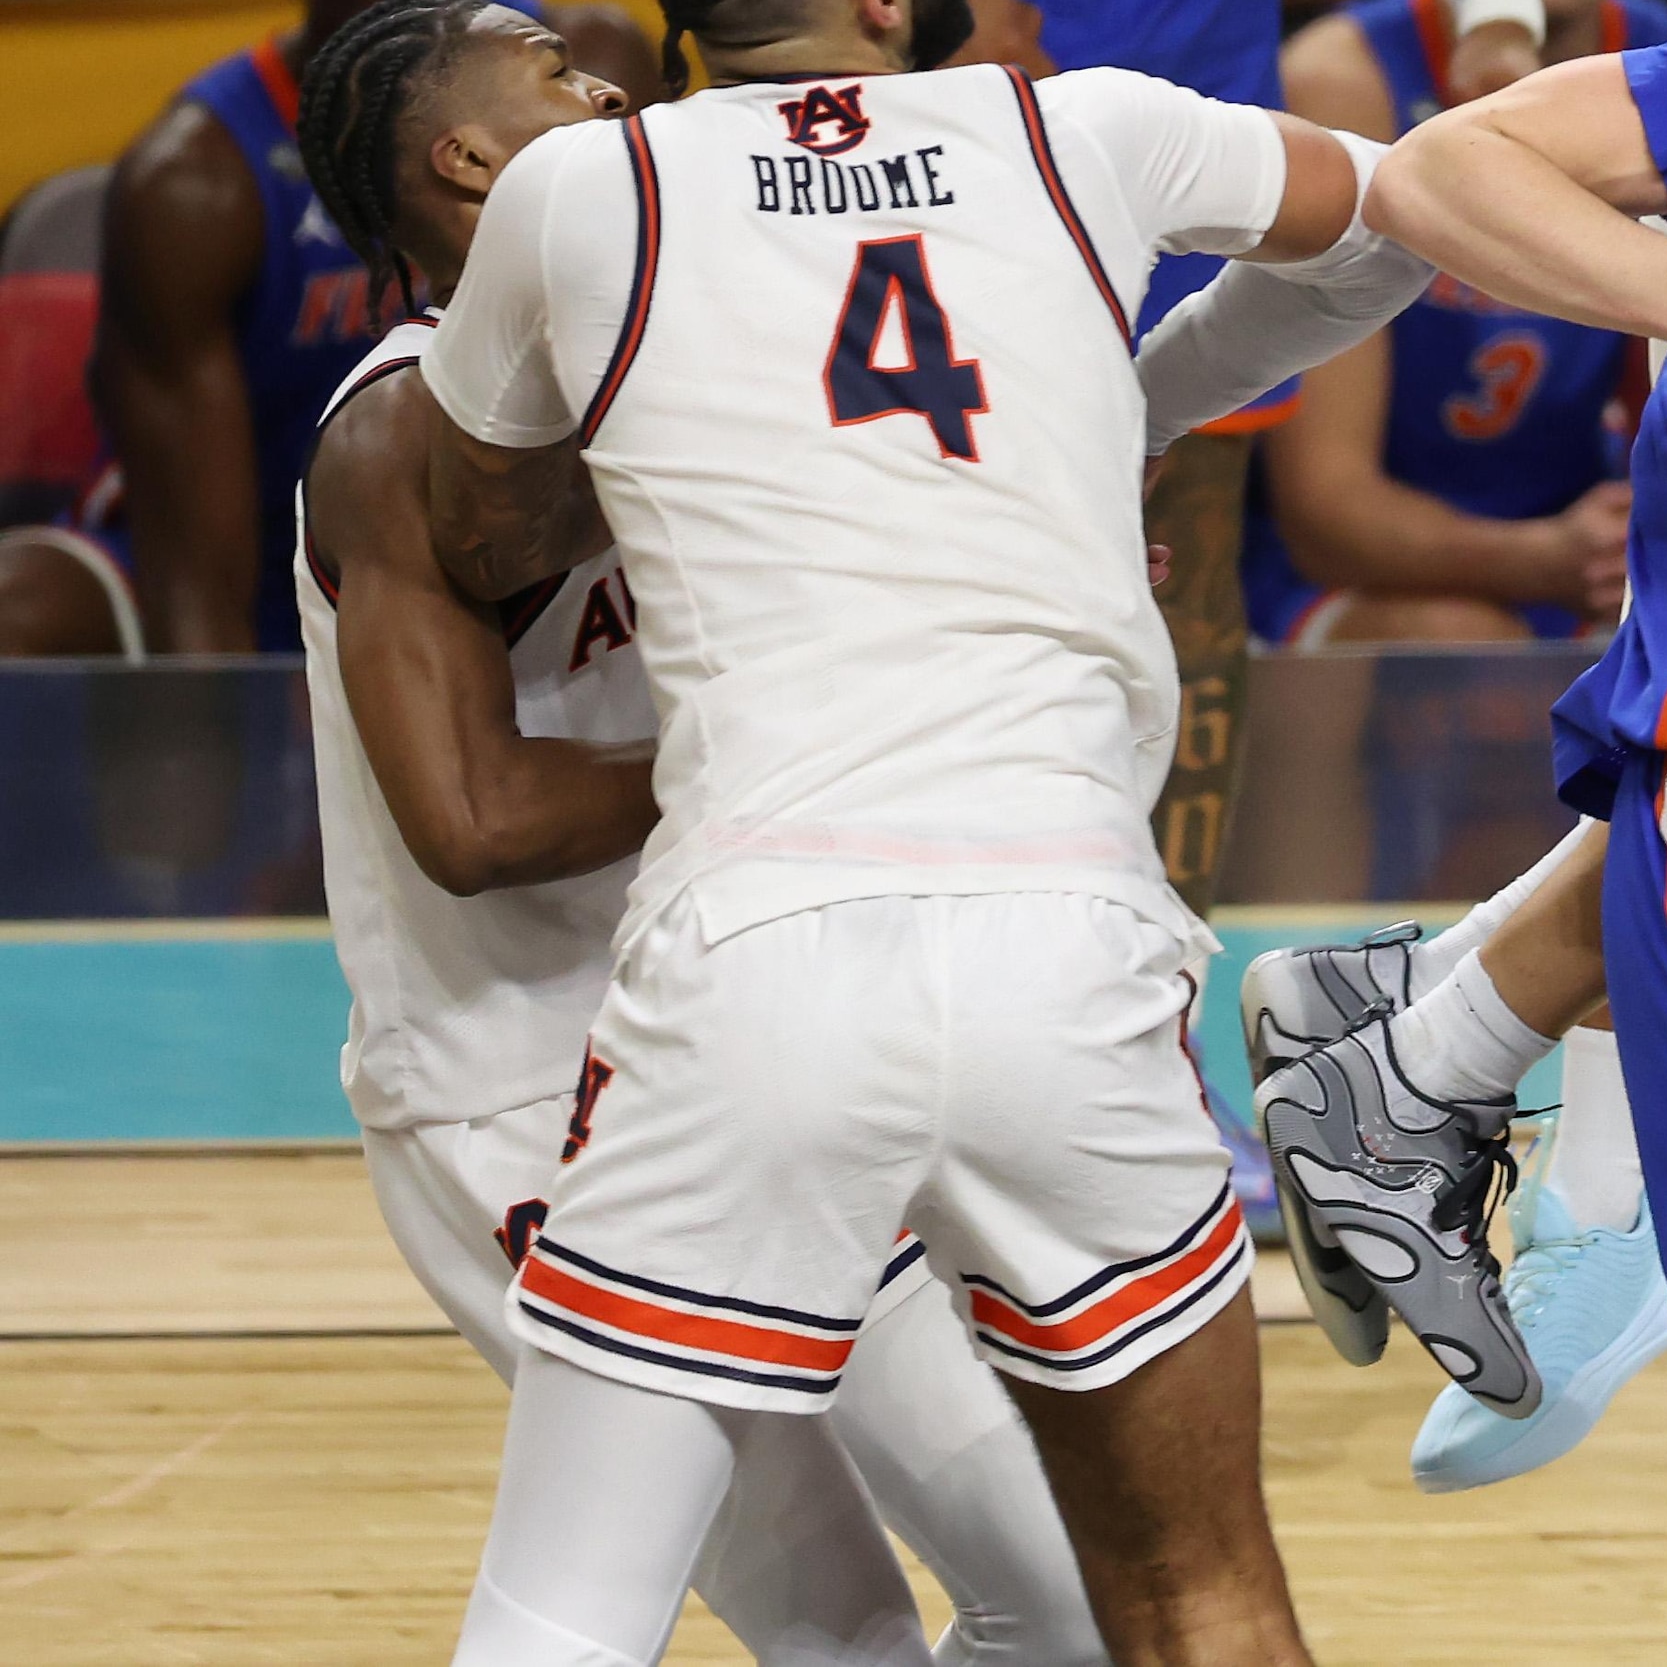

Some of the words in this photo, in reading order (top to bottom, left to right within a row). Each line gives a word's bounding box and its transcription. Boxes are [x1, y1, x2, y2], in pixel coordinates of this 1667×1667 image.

[750, 144, 955, 215] BROOME
[822, 231, 991, 464] 4
[1440, 328, 1546, 442] 3
